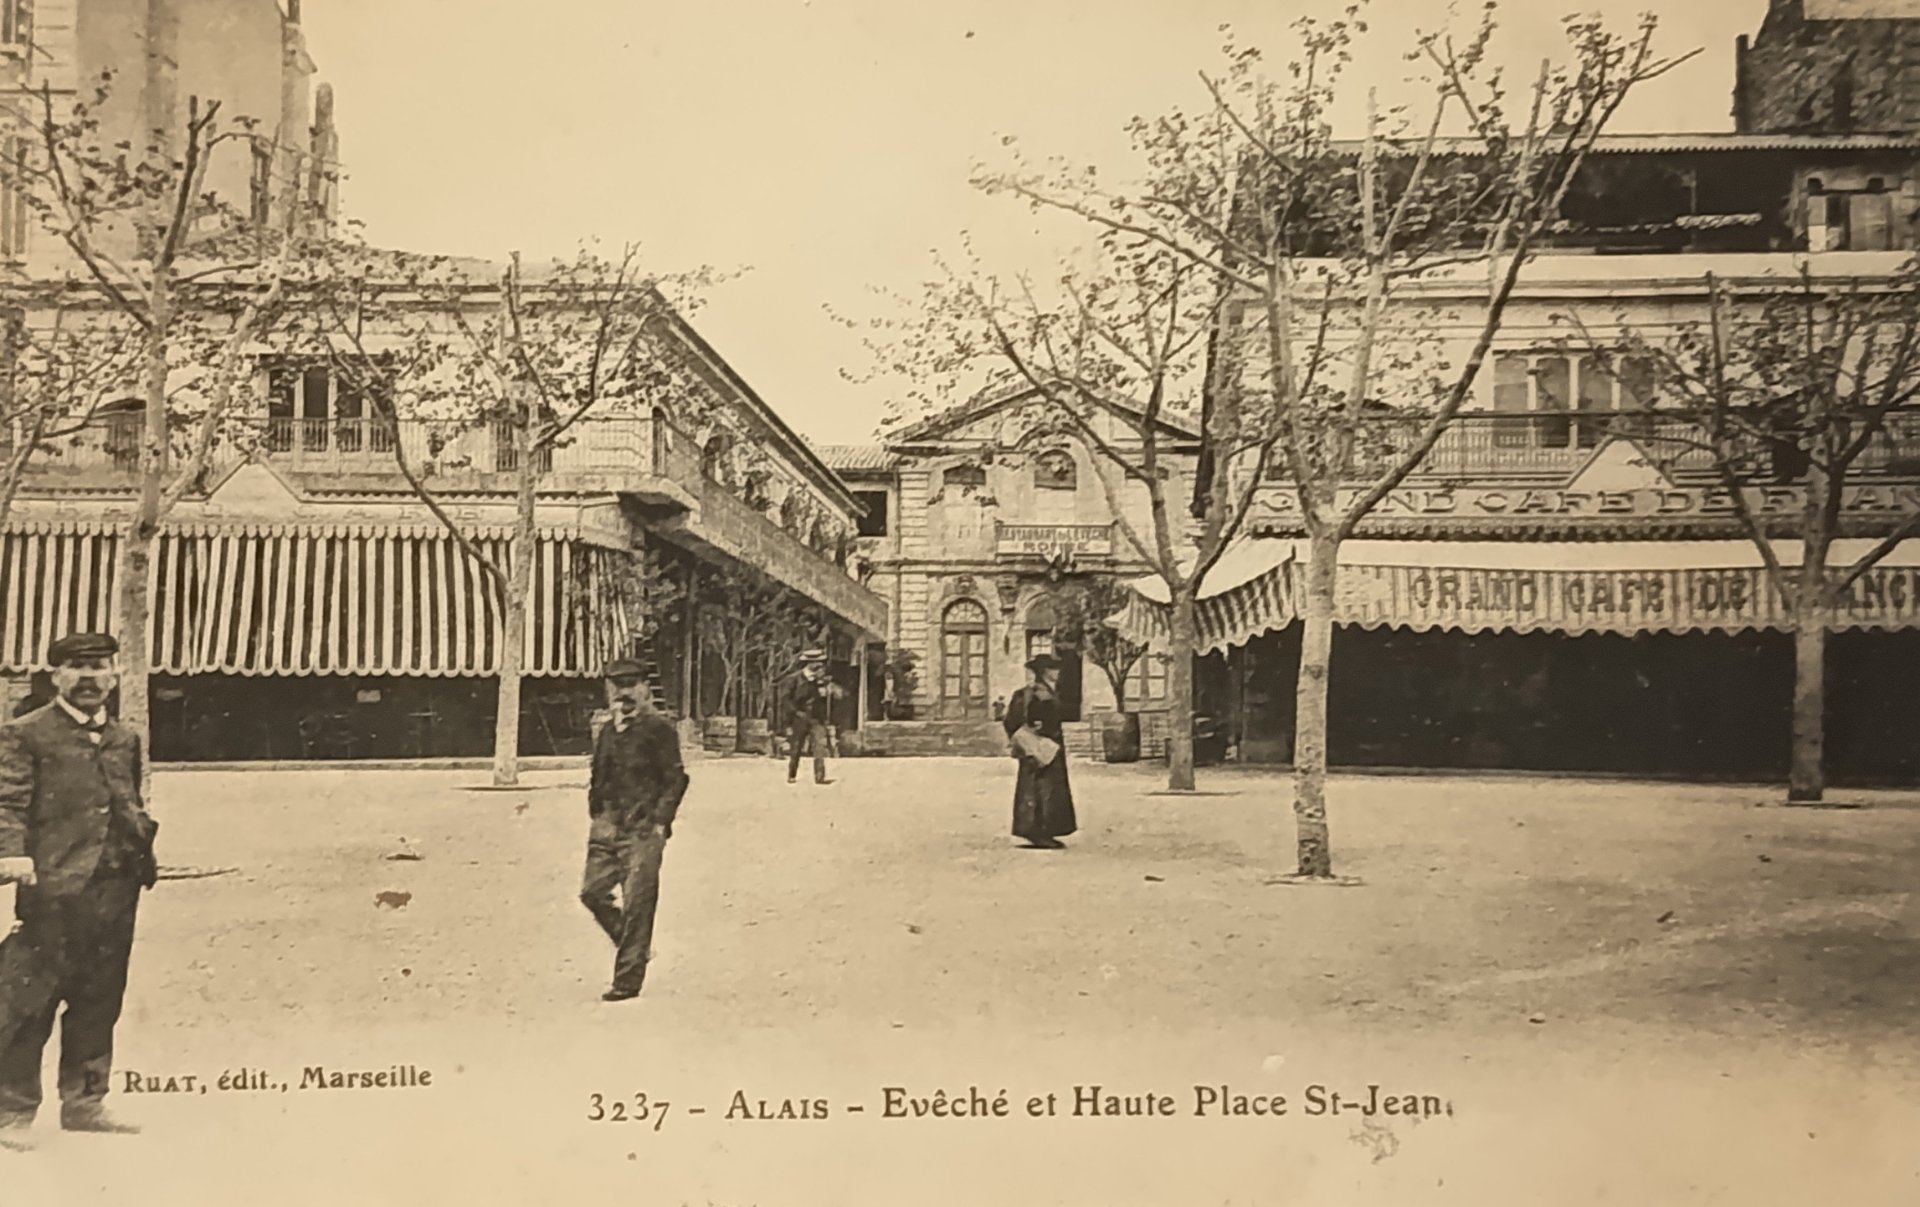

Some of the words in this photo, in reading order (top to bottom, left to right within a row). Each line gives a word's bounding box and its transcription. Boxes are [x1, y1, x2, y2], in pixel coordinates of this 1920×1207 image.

[1261, 491, 1455, 513] GAND
[1473, 490, 1635, 513] CAFE
[1411, 572, 1537, 612] GRAND
